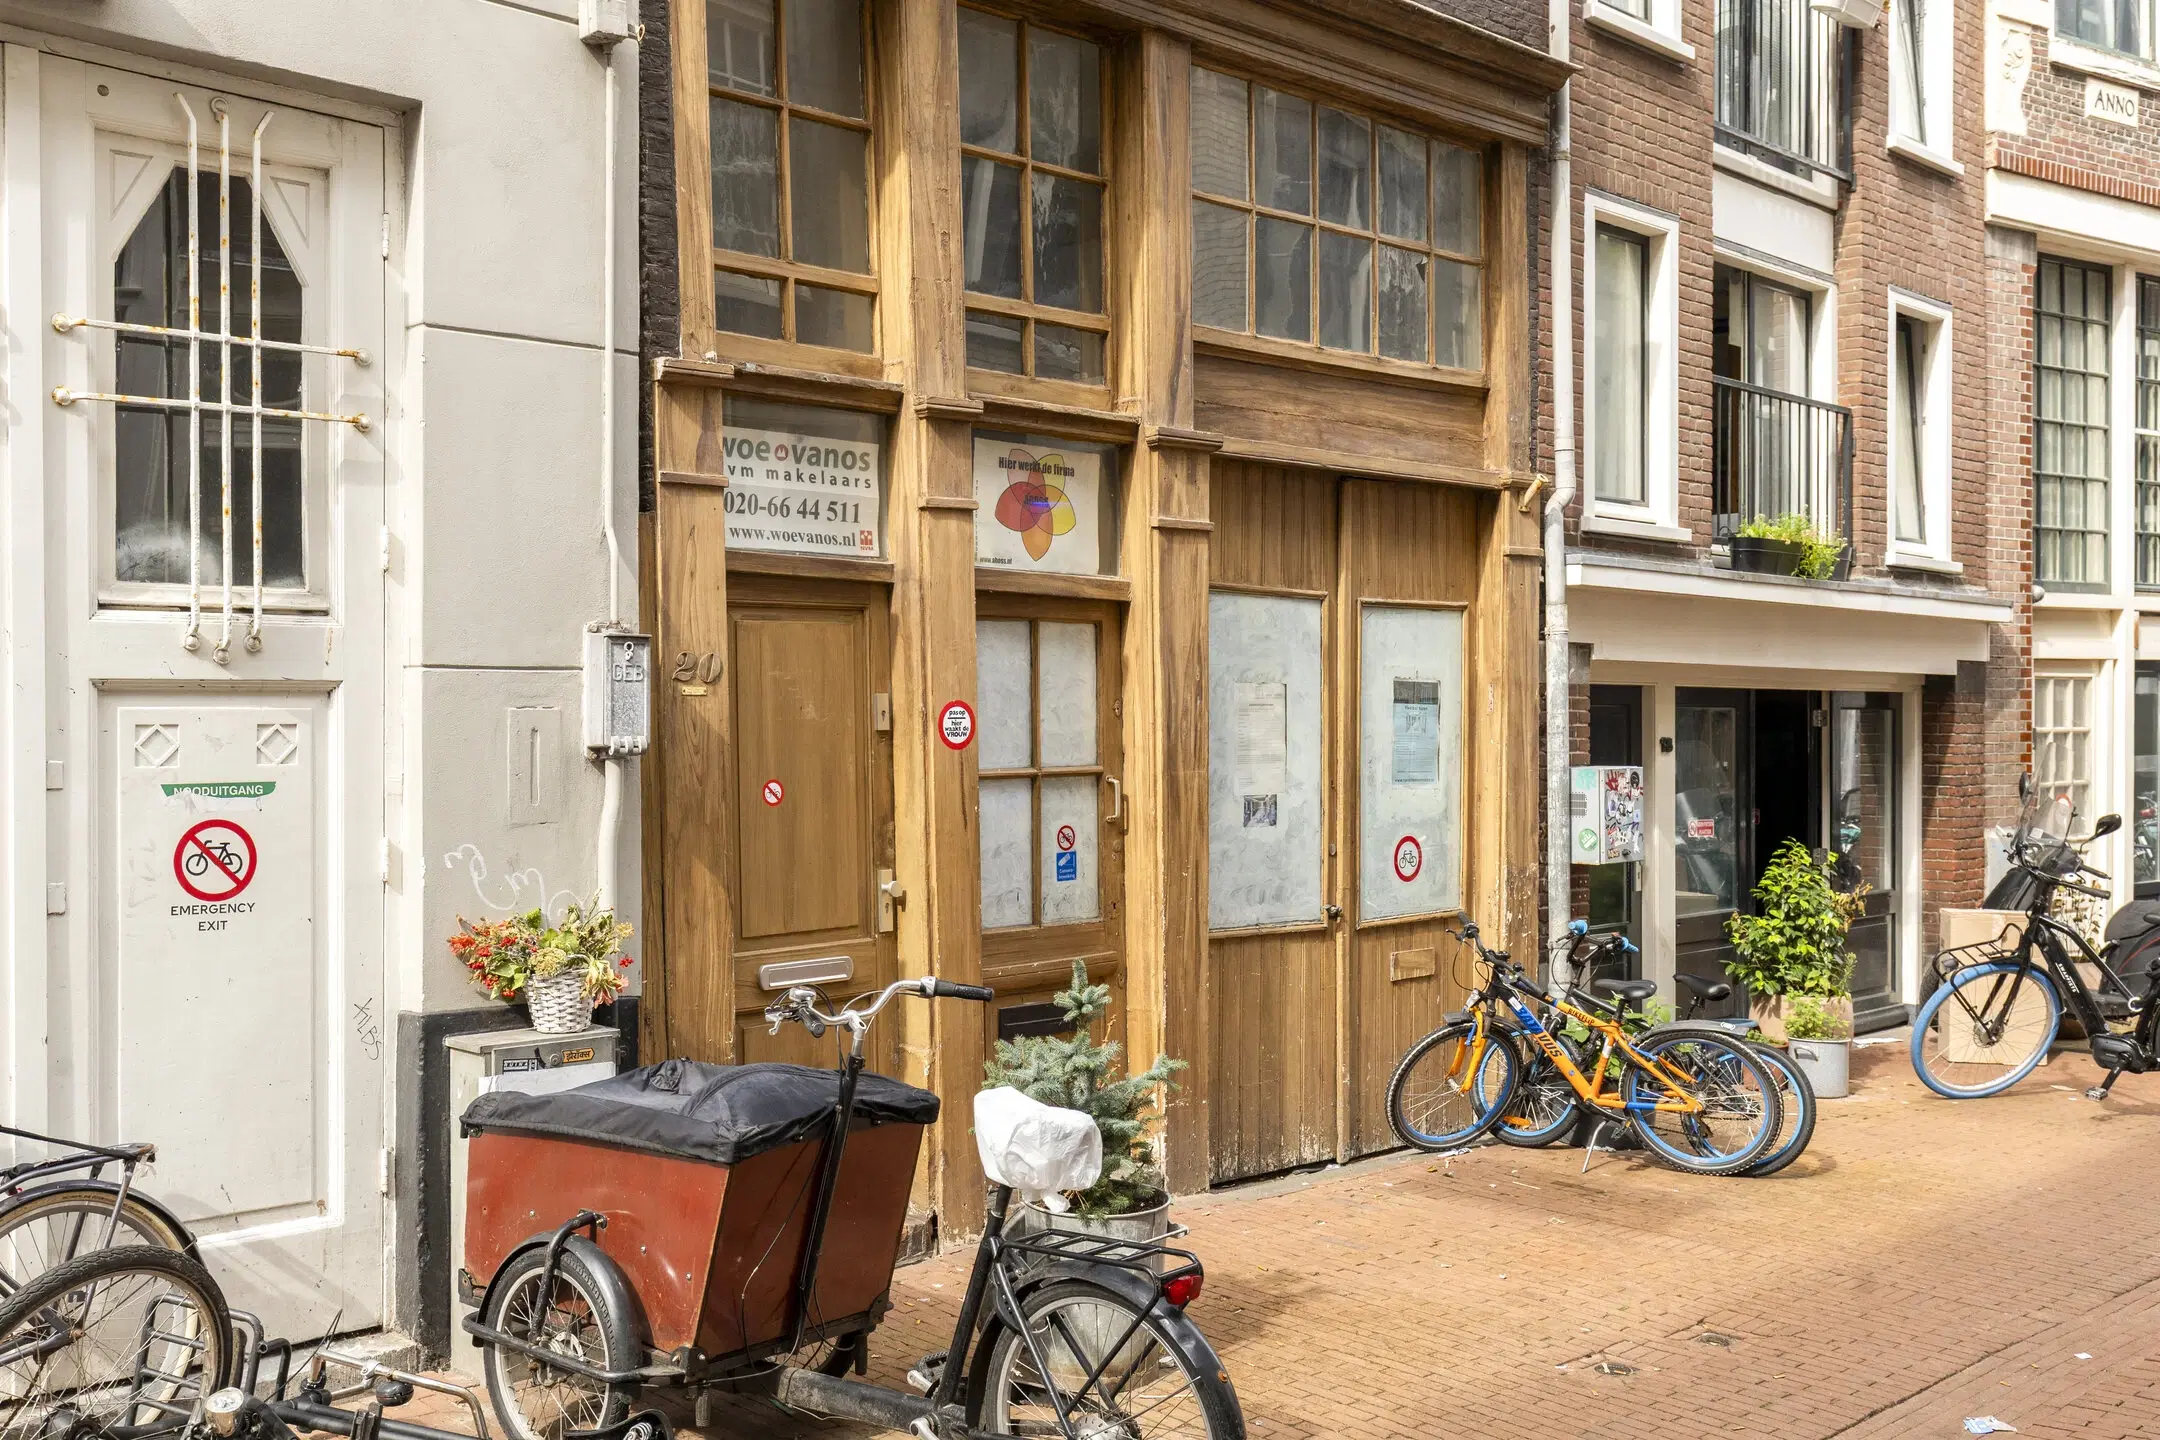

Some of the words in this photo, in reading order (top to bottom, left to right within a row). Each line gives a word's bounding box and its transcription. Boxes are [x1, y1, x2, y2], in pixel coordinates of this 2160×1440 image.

[2094, 89, 2135, 117] ANNO
[791, 444, 871, 472] vanos
[998, 456, 1016, 470] Hier
[1041, 461, 1052, 473] de
[1053, 464, 1075, 477] firma
[766, 467, 872, 489] makelaars
[724, 491, 791, 519] 020-66
[797, 498, 820, 521] 44
[826, 501, 861, 524] 511
[729, 526, 857, 547] www.woevanos.nl
[613, 663, 644, 682] GEB
[671, 651, 722, 684] 20
[170, 902, 256, 916] EMERGENCY
[198, 920, 228, 932] EXIT
